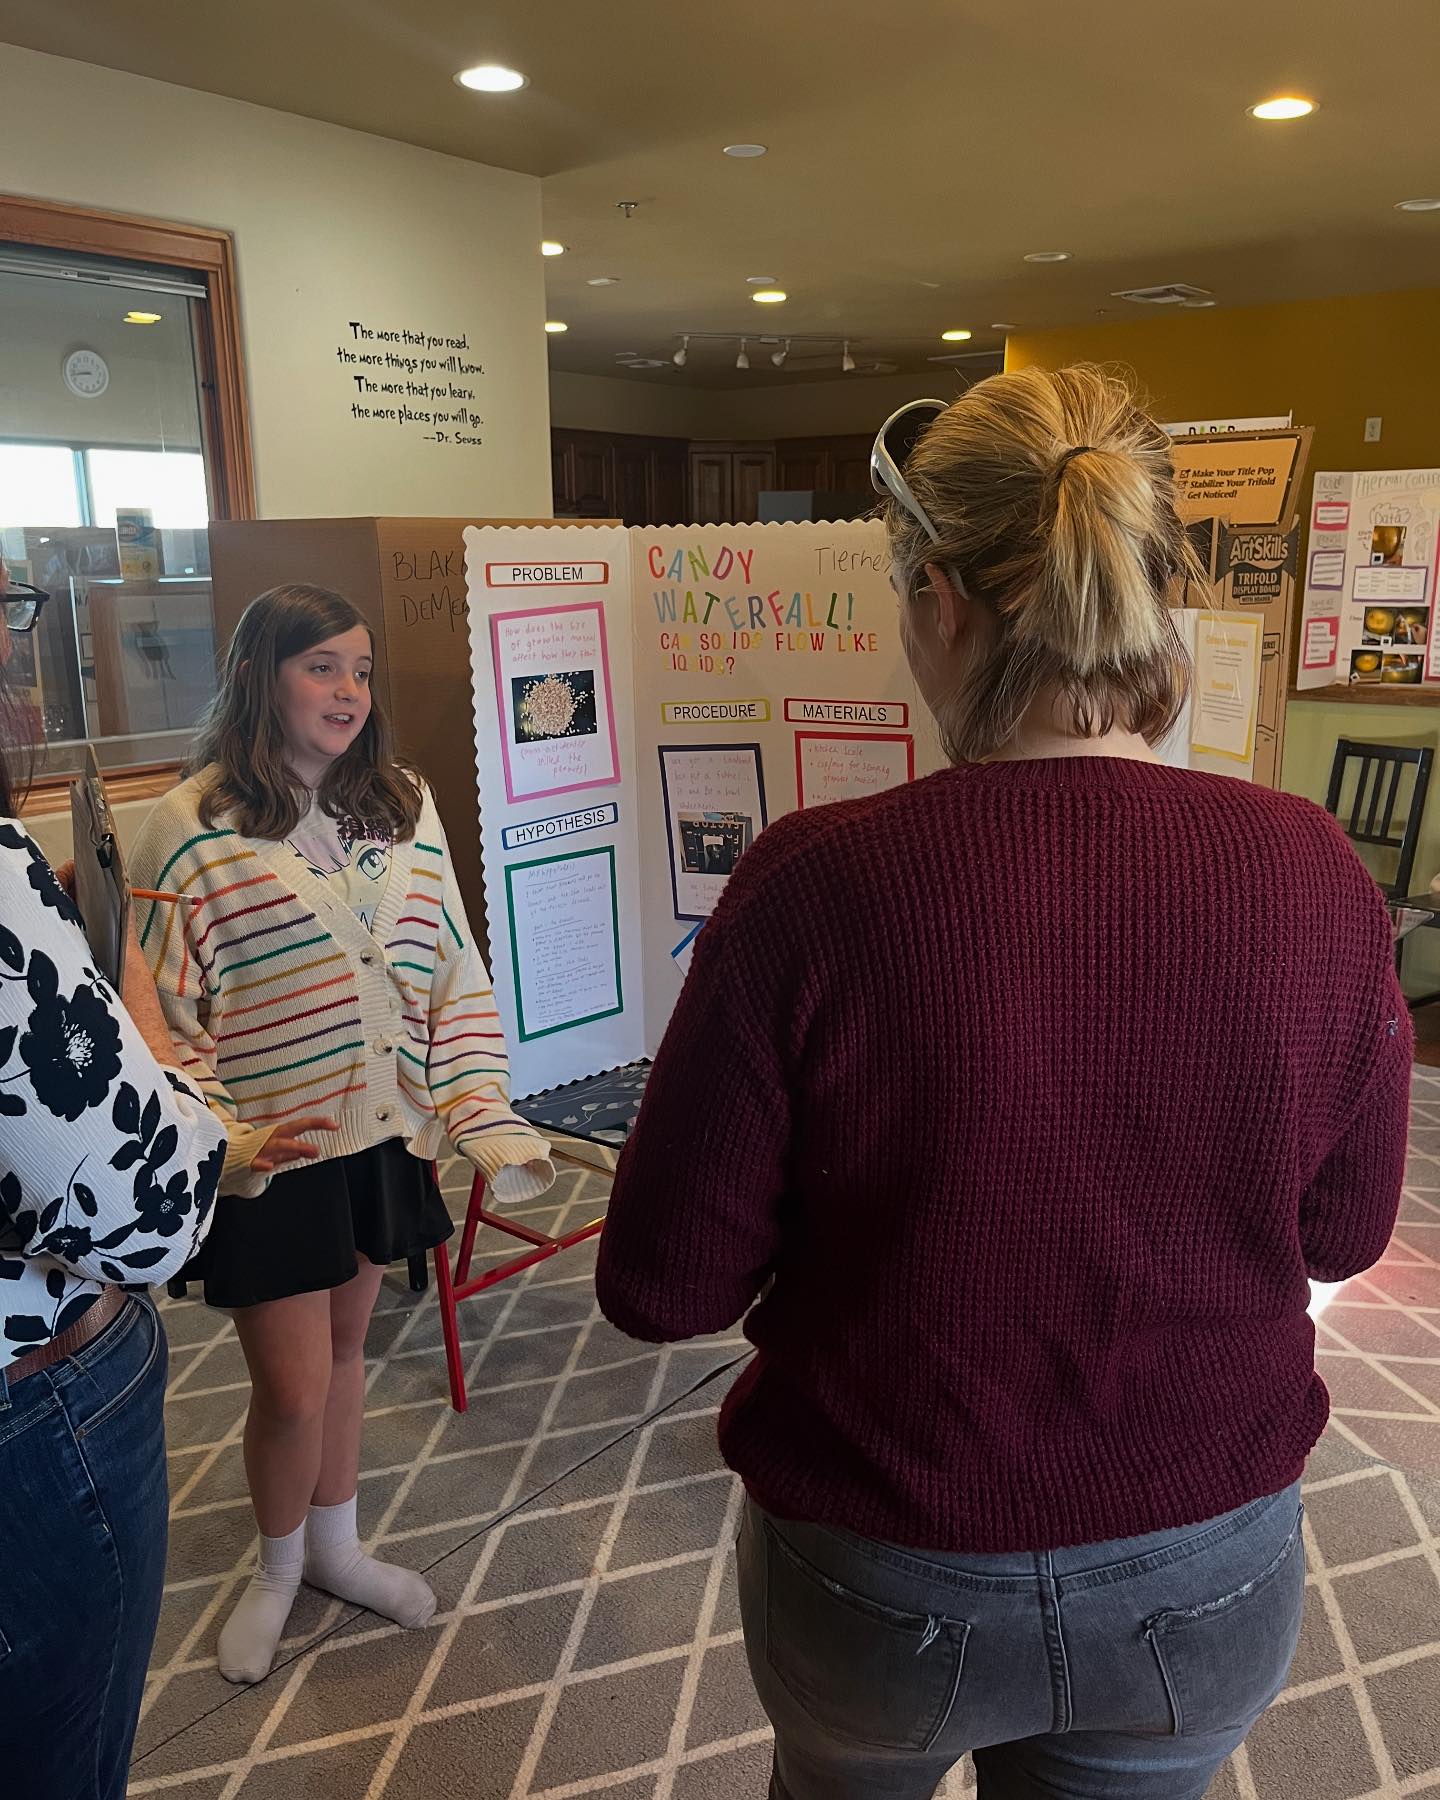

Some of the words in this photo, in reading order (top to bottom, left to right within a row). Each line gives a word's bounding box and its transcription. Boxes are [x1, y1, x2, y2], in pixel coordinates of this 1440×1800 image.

[349, 322, 374, 340] The
[377, 331, 400, 342] more
[402, 329, 425, 346] that
[428, 336, 444, 350] you
[336, 347, 356, 364] the
[359, 354, 383, 366] more
[385, 352, 418, 374] things
[420, 359, 436, 373] you
[438, 356, 456, 372] will
[458, 357, 485, 375] know.
[354, 376, 378, 393] The
[381, 385, 404, 394] more
[406, 381, 428, 398] that
[430, 387, 446, 400] you
[351, 403, 370, 419] the
[372, 408, 396, 420] more
[398, 404, 430, 425] places
[433, 412, 448, 426] you
[451, 408, 468, 424] will
[470, 416, 484, 428] go.
[455, 432, 482, 445] Seuss
[1192, 469, 1214, 478] Make
[1216, 468, 1235, 476] Your
[1238, 467, 1256, 476] Title
[1258, 467, 1274, 476] Pop
[1190, 480, 1224, 488] Stabilize
[1248, 476, 1276, 486] Trifold
[1203, 490, 1238, 498] Noticed!
[1230, 535, 1288, 560] ArtSkills
[648, 545, 754, 584] CANDY
[512, 566, 583, 582] PROBLEM
[1238, 572, 1278, 584] TRIFOLD
[1234, 586, 1258, 595] DISPLAY
[1260, 584, 1280, 594] BOARD
[654, 589, 855, 630] WATERFALL!
[660, 632, 691, 650] CAN
[700, 632, 763, 650] SOLIDS
[776, 632, 824, 651] FLOW
[838, 632, 878, 652] LIKE
[674, 704, 757, 719] PROCEDURE
[803, 704, 888, 721] MATERIALS
[516, 809, 606, 843] HYPOTHESIS
